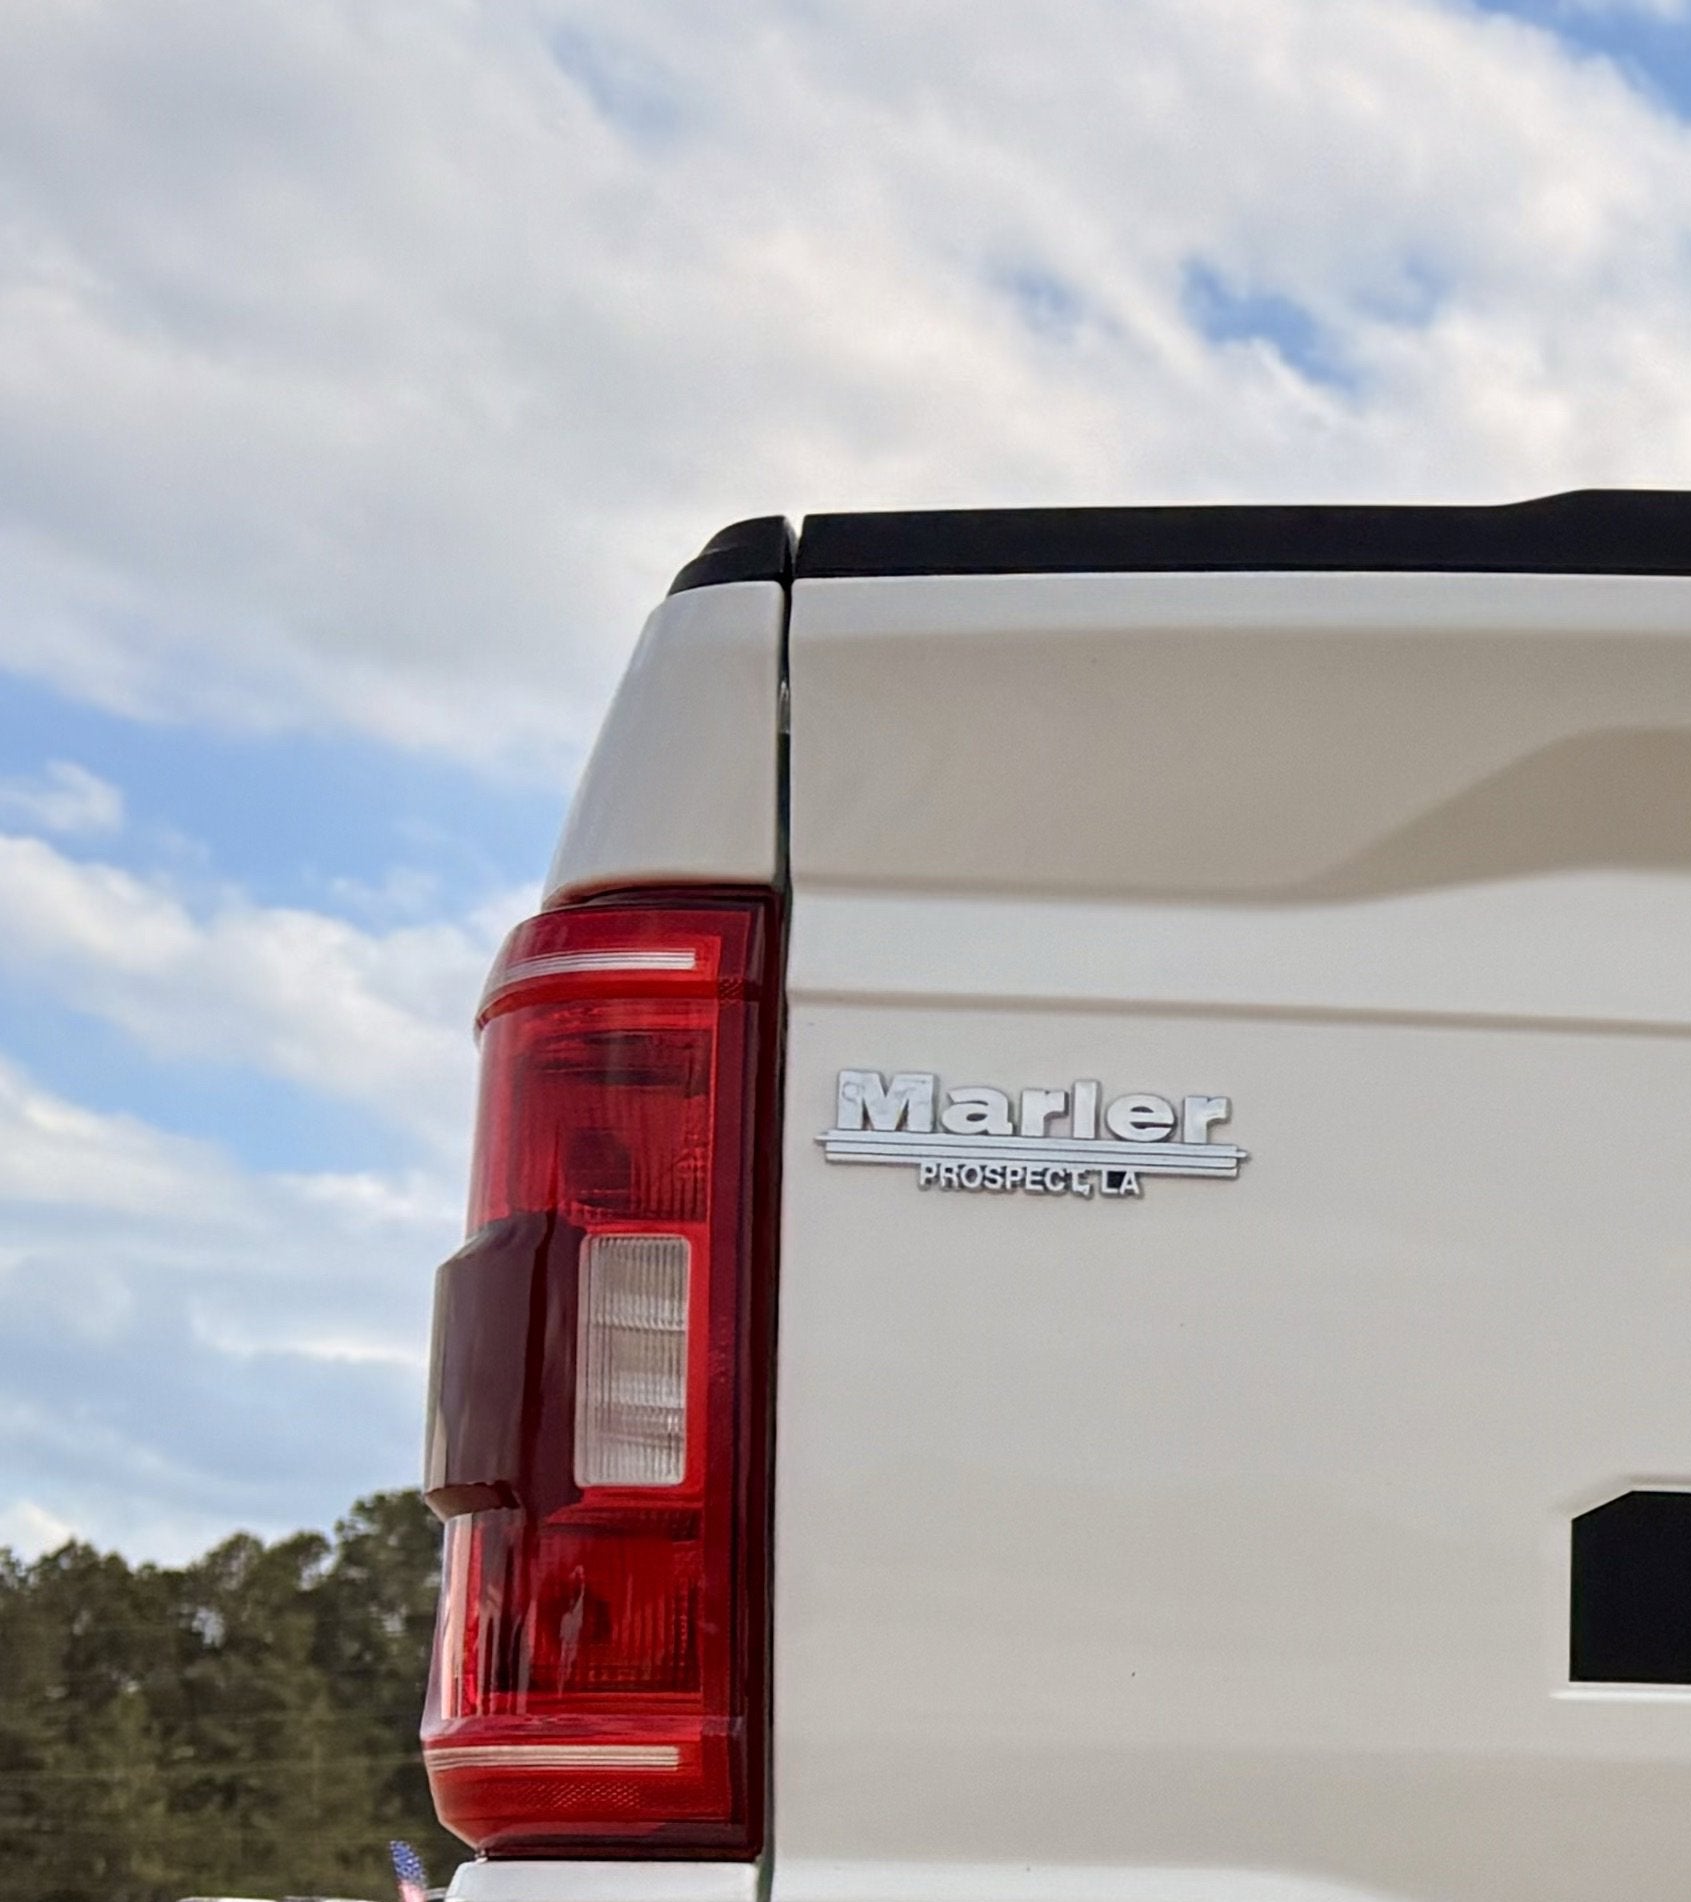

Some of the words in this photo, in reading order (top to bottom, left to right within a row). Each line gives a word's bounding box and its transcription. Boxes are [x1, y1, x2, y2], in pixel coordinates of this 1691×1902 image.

[836, 1069, 1232, 1144] Marler
[918, 1161, 1092, 1198] PROSPECT,
[1099, 1168, 1140, 1196] LA
